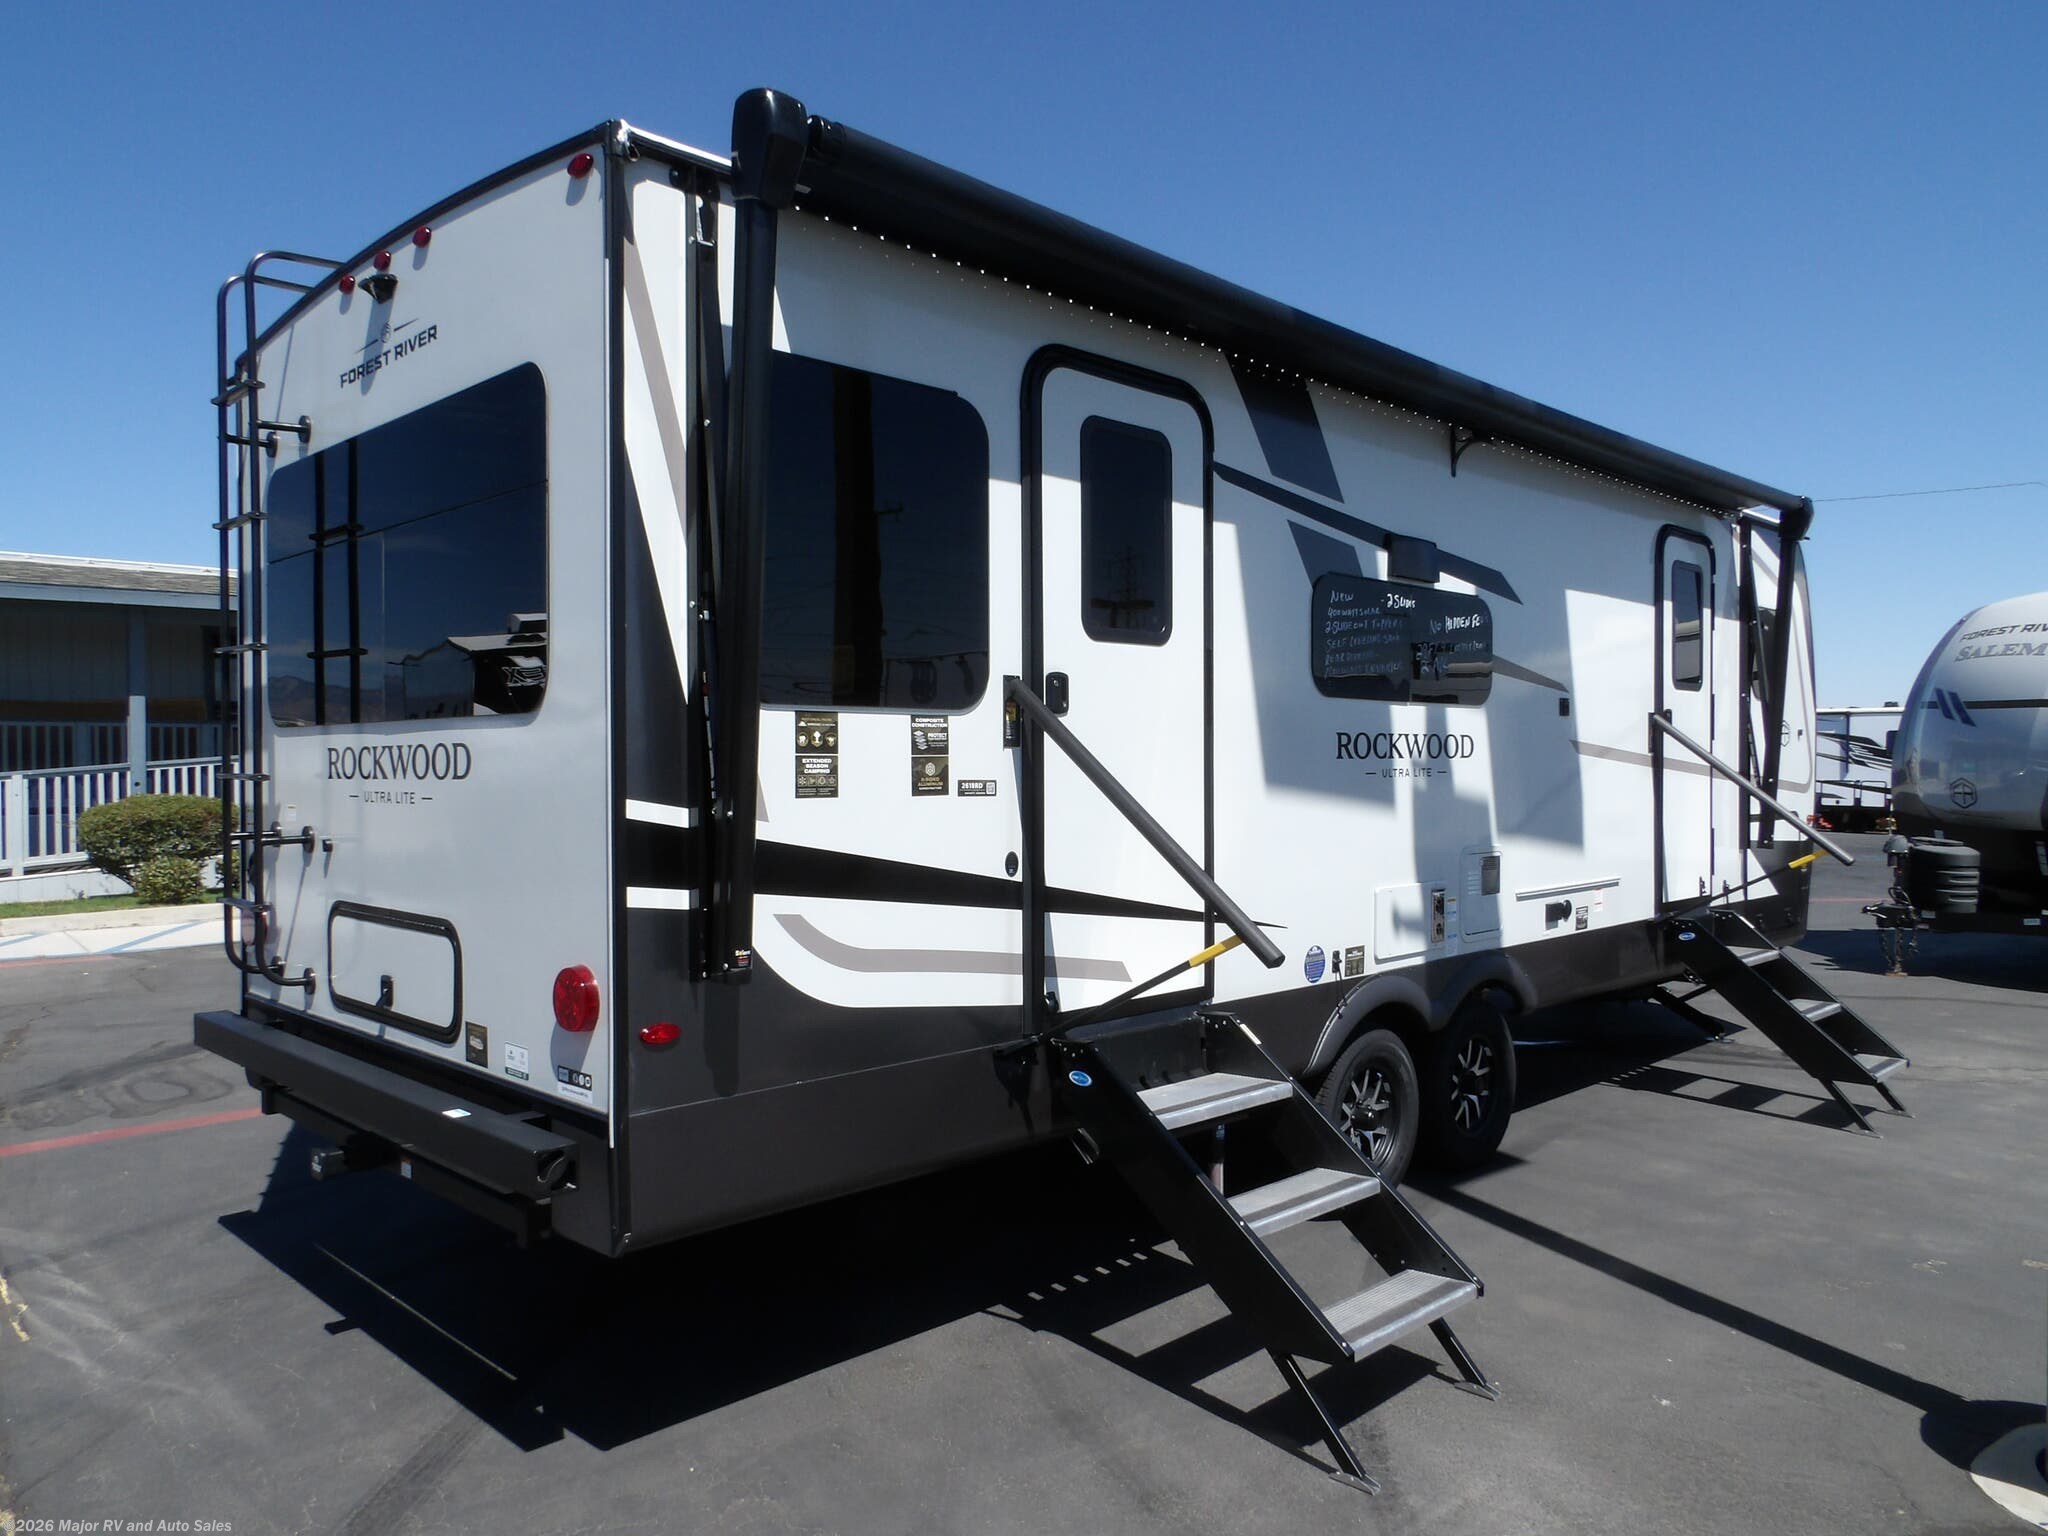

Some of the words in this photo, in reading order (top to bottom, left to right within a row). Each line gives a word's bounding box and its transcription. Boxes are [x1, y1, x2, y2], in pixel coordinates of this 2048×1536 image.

[340, 350, 391, 388] FOREST
[394, 325, 438, 360] RIVER
[1960, 625, 2021, 641] FOREST
[1955, 643, 2048, 662] SALEM
[1336, 732, 1474, 760] ROCKWOOD
[327, 743, 472, 780] ROCKWOOD
[1382, 768, 1410, 778] ULTRA
[1413, 768, 1432, 777] LITE
[364, 791, 392, 803] ULTRA
[395, 792, 415, 804] LITE
